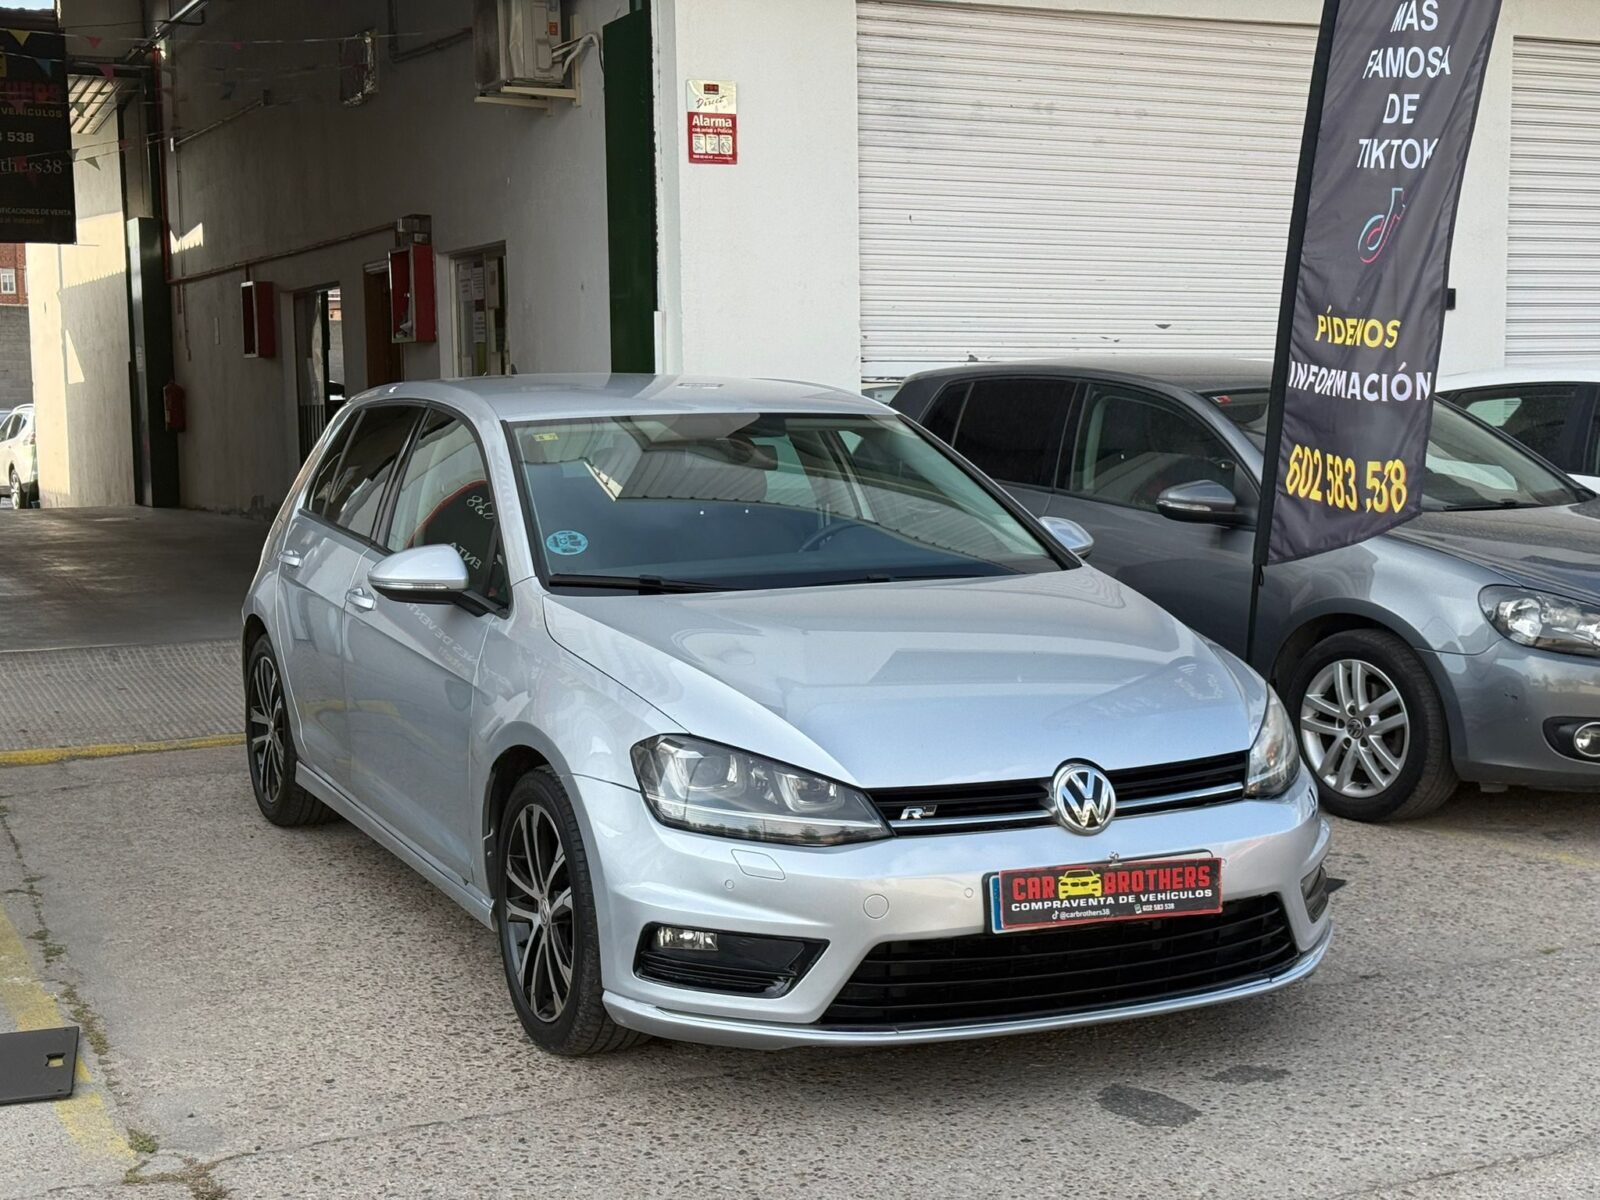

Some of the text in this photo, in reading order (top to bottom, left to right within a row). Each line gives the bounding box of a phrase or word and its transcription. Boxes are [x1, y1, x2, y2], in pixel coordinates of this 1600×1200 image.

[1362, 45, 1451, 79] FAMOSA
[692, 115, 732, 127] Alarma
[1382, 93, 1420, 124] DE
[7, 132, 34, 143] 538
[1288, 361, 1432, 402] INFORMACIÓN
[1285, 444, 1322, 502] 602
[1326, 453, 1358, 512] 583
[1012, 865, 1210, 900] CAR BROTHERS
[1011, 889, 1212, 911] COMPRAVENTA DE VEHÍCULOS
[1059, 908, 1110, 920] @carbrothers38
